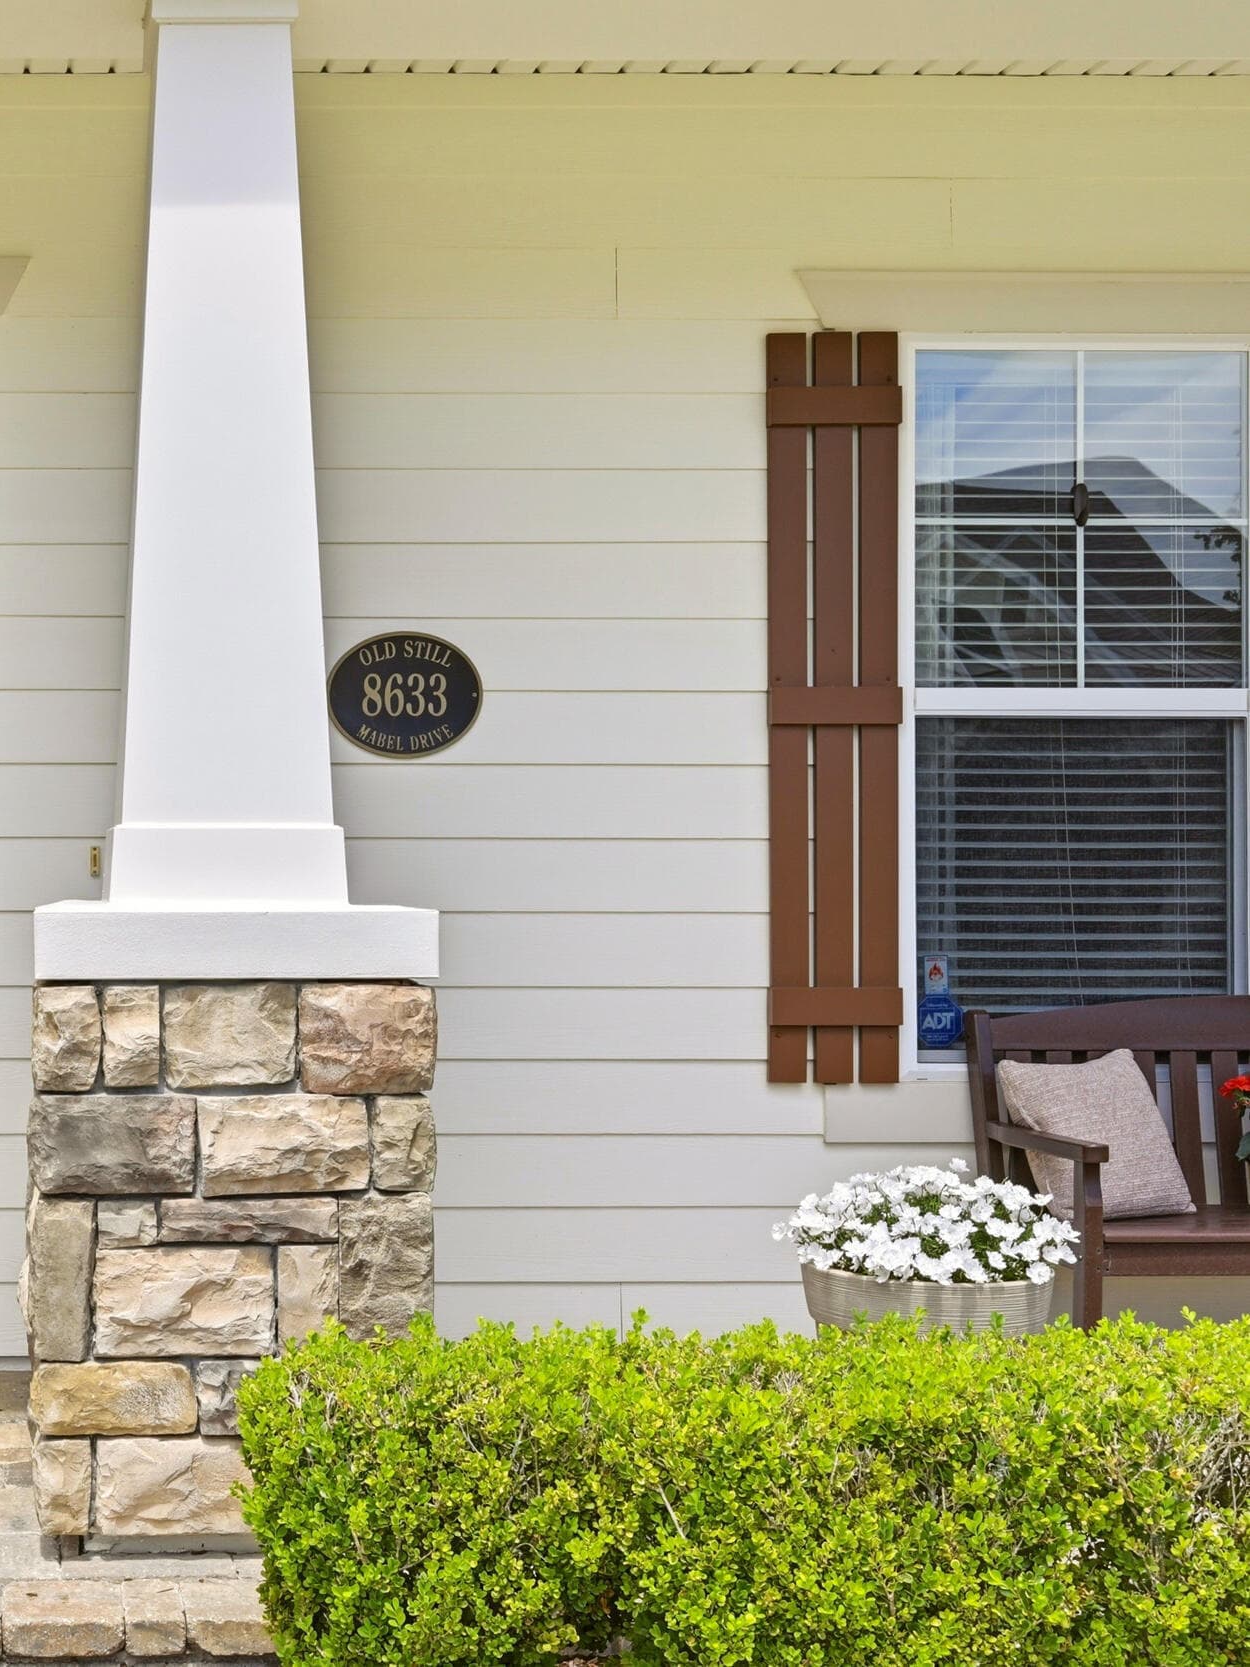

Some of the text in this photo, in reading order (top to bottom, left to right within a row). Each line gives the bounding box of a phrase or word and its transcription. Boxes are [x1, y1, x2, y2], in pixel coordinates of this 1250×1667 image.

[359, 640, 452, 668] OLD STILL
[361, 673, 447, 717] 8633
[356, 723, 454, 751] MABEL DRIVE
[922, 1012, 955, 1030] ADT
